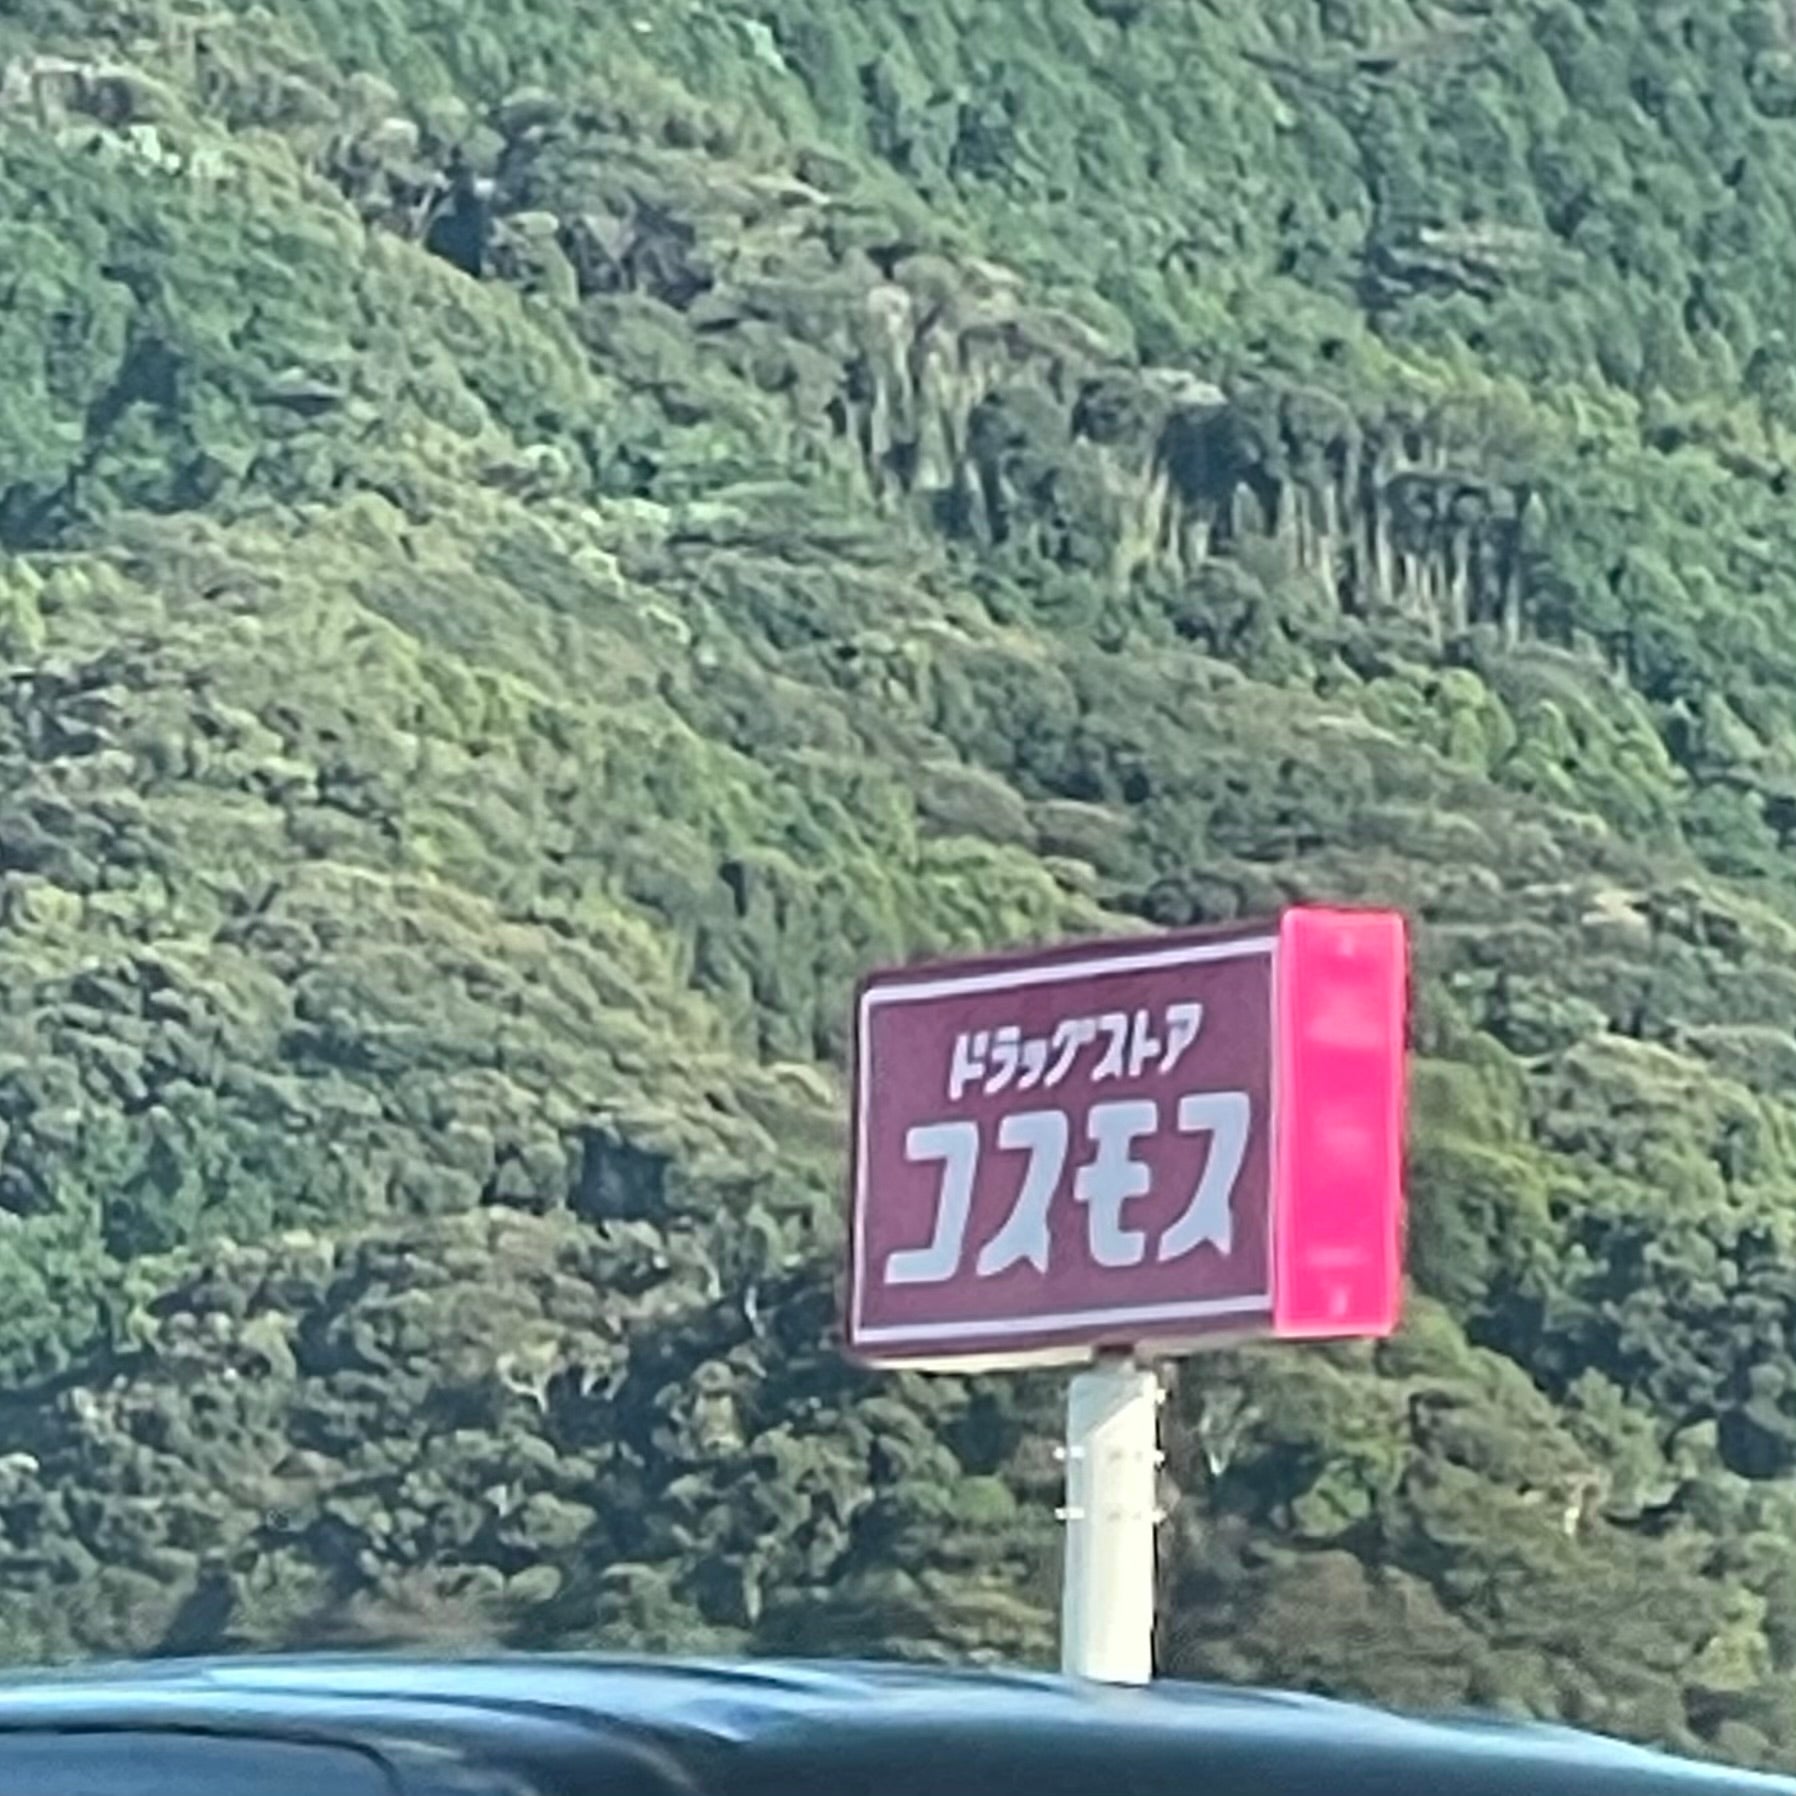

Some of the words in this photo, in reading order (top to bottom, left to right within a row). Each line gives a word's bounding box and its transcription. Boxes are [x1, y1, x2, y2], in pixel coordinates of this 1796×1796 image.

[949, 1003, 1203, 1099] ドラッグストア
[884, 1091, 1250, 1283] コスモス
